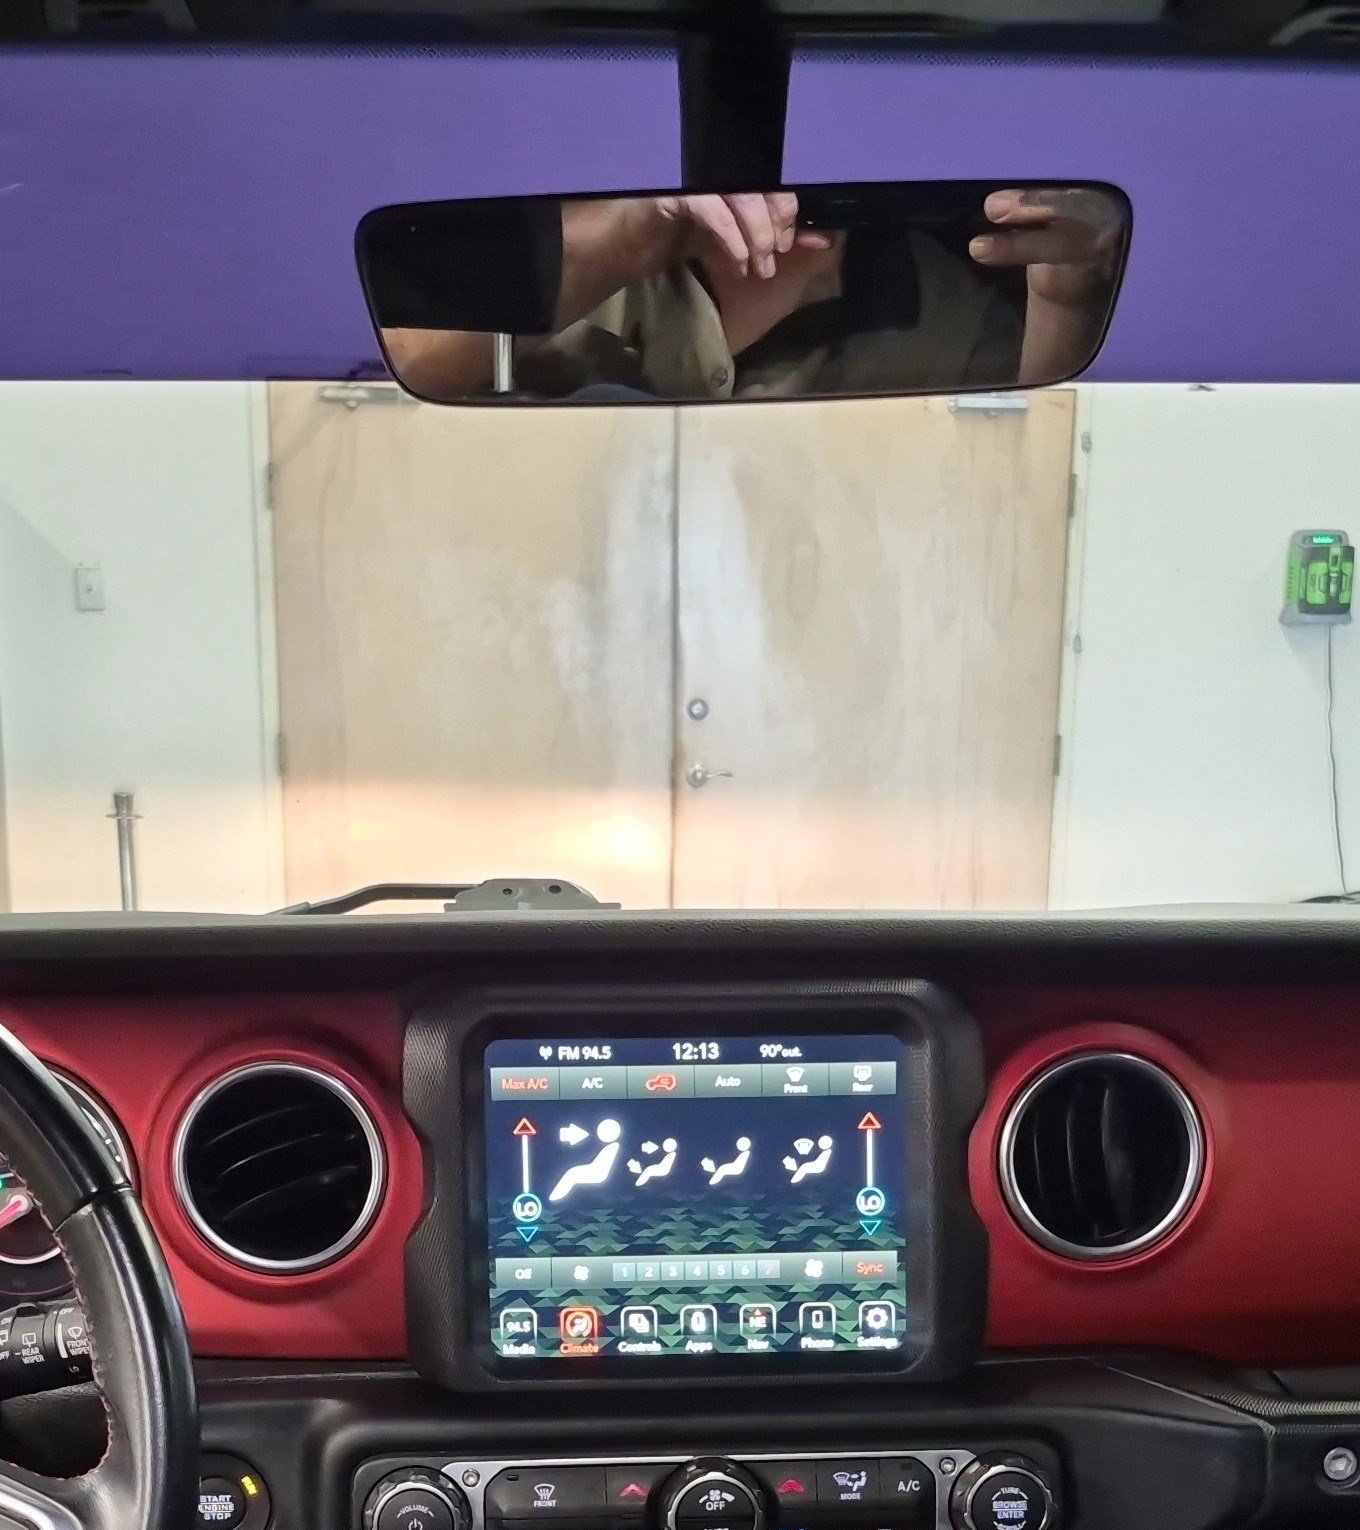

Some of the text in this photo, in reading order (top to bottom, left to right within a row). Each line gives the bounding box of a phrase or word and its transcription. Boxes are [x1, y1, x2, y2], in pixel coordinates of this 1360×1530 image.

[558, 1045, 612, 1060] FM 94.5
[672, 1042, 719, 1060] 12:13
[502, 1078, 548, 1090] Max A/C
[581, 1077, 604, 1089] A/C
[715, 1075, 741, 1087] Auto
[783, 1083, 808, 1094] Front
[852, 1083, 873, 1092] Rear
[860, 1195, 881, 1210] LO
[516, 1201, 537, 1217] LO
[515, 1268, 533, 1280] Off
[645, 1266, 654, 1278] 2
[668, 1266, 678, 1277] 3
[693, 1265, 702, 1277] 4
[717, 1265, 726, 1276] 5
[741, 1264, 750, 1276] 6
[857, 1261, 884, 1276] Sync
[506, 1321, 531, 1333] 94.5
[749, 1317, 766, 1328] NE
[560, 1343, 599, 1353] Climate
[618, 1341, 662, 1353] Controls
[686, 1340, 713, 1353] Apps
[747, 1339, 769, 1350] Nav
[801, 1337, 835, 1348] Phone
[857, 1336, 898, 1349] Settings
[502, 1343, 535, 1355] Media
[897, 1480, 921, 1493] A/C
[200, 1494, 232, 1502] START
[400, 1504, 430, 1516] VOLUME
[706, 1501, 725, 1511] OFF
[992, 1500, 1028, 1509] BROWSE
[203, 1512, 232, 1520] STOP
[997, 1511, 1025, 1519] ENTER
